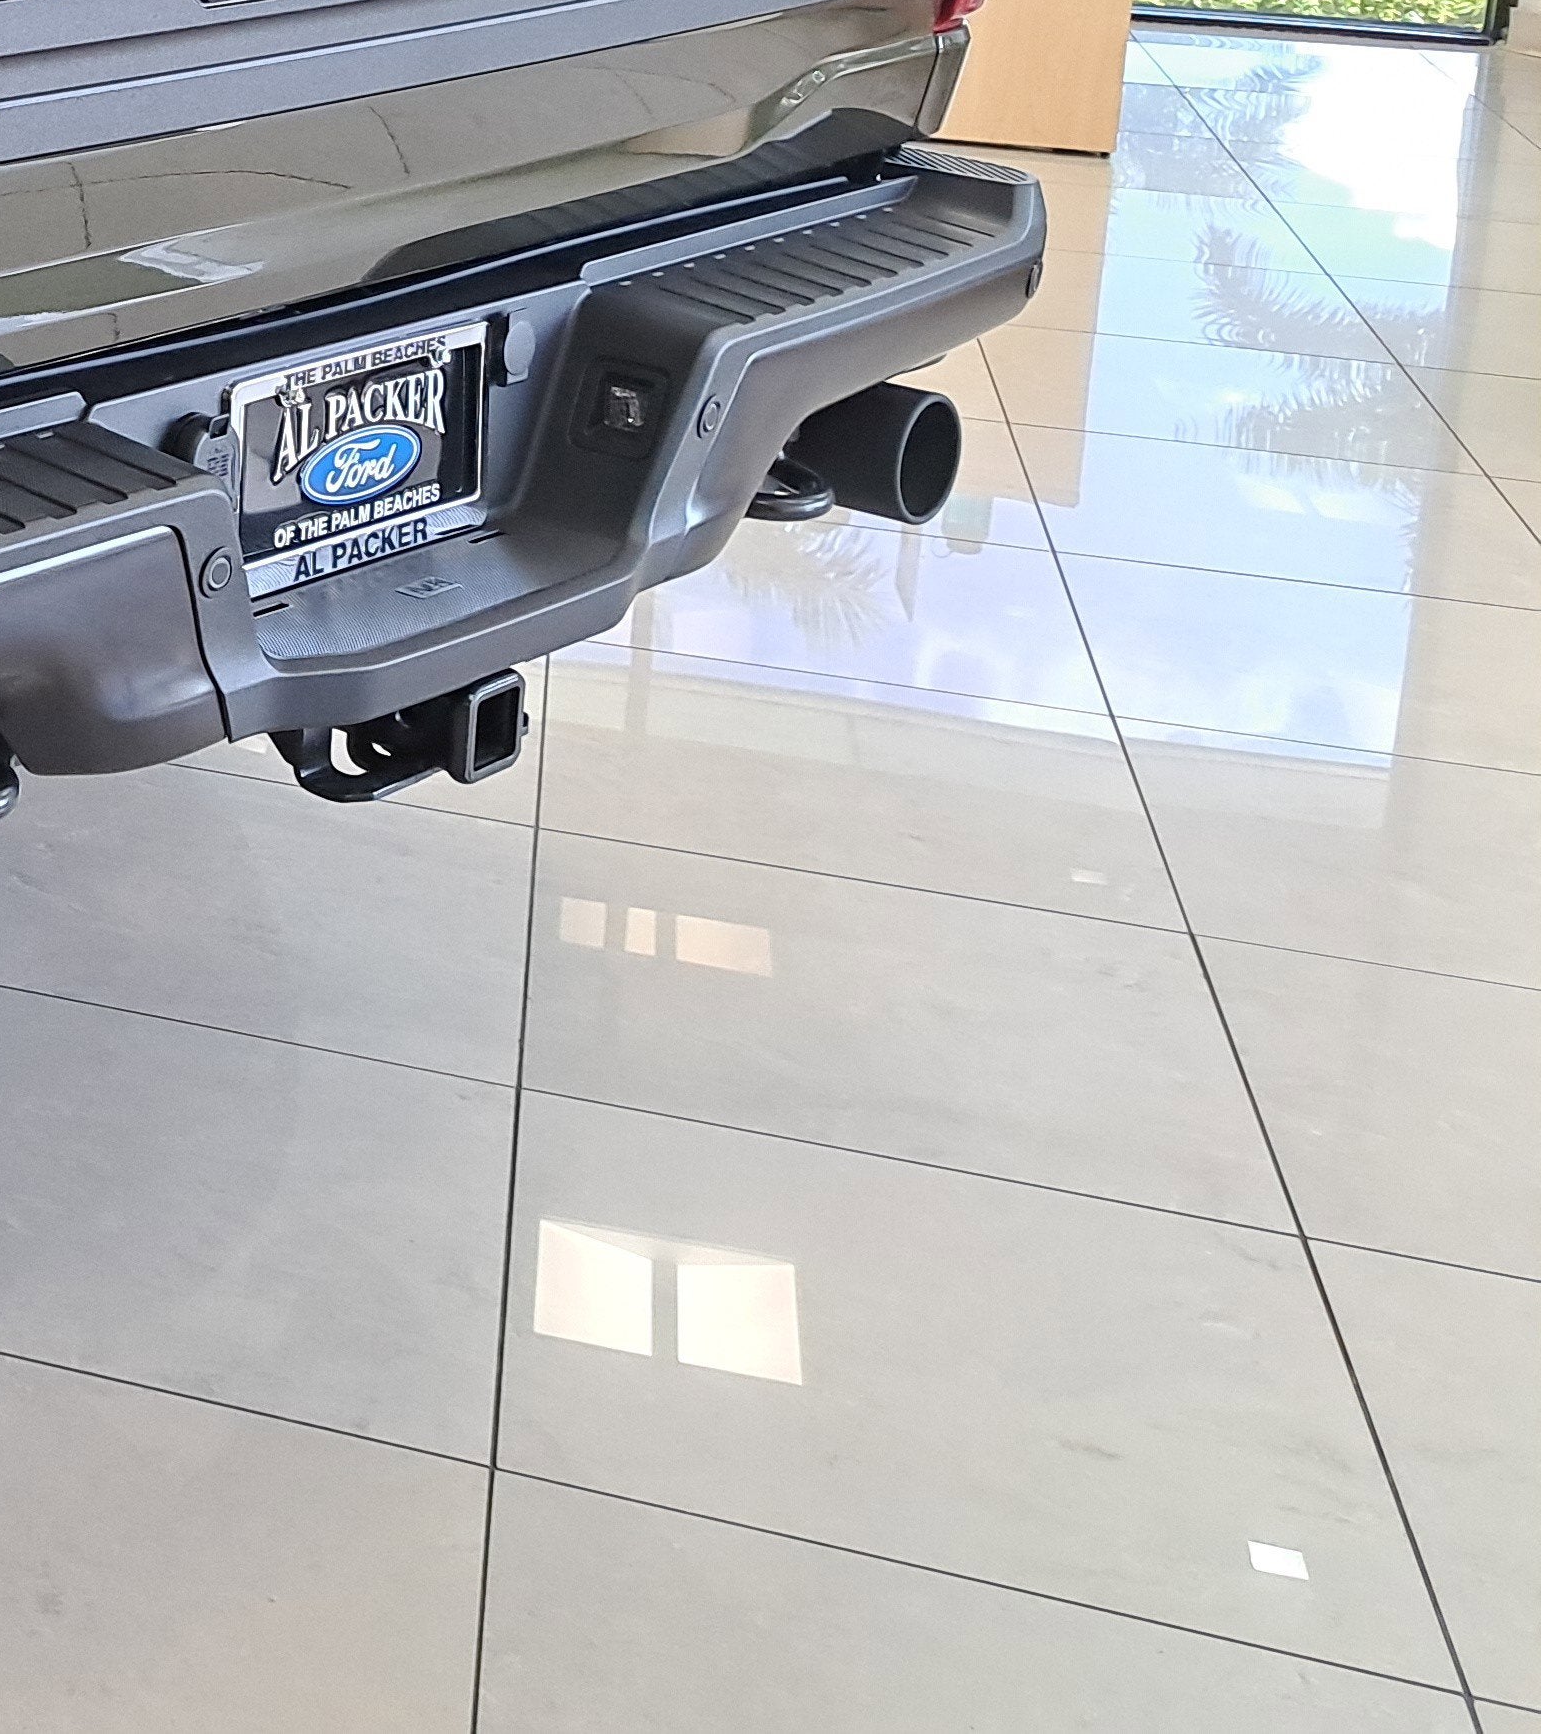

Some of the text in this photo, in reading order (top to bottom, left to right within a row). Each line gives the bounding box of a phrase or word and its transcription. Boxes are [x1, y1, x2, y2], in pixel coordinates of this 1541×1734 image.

[284, 336, 446, 387] THE PALM BEACHES
[273, 369, 446, 482] AL PACKER
[325, 438, 396, 493] Ford
[274, 483, 441, 549] OF THE PALM BEACHES
[294, 517, 428, 582] AL PACKER
